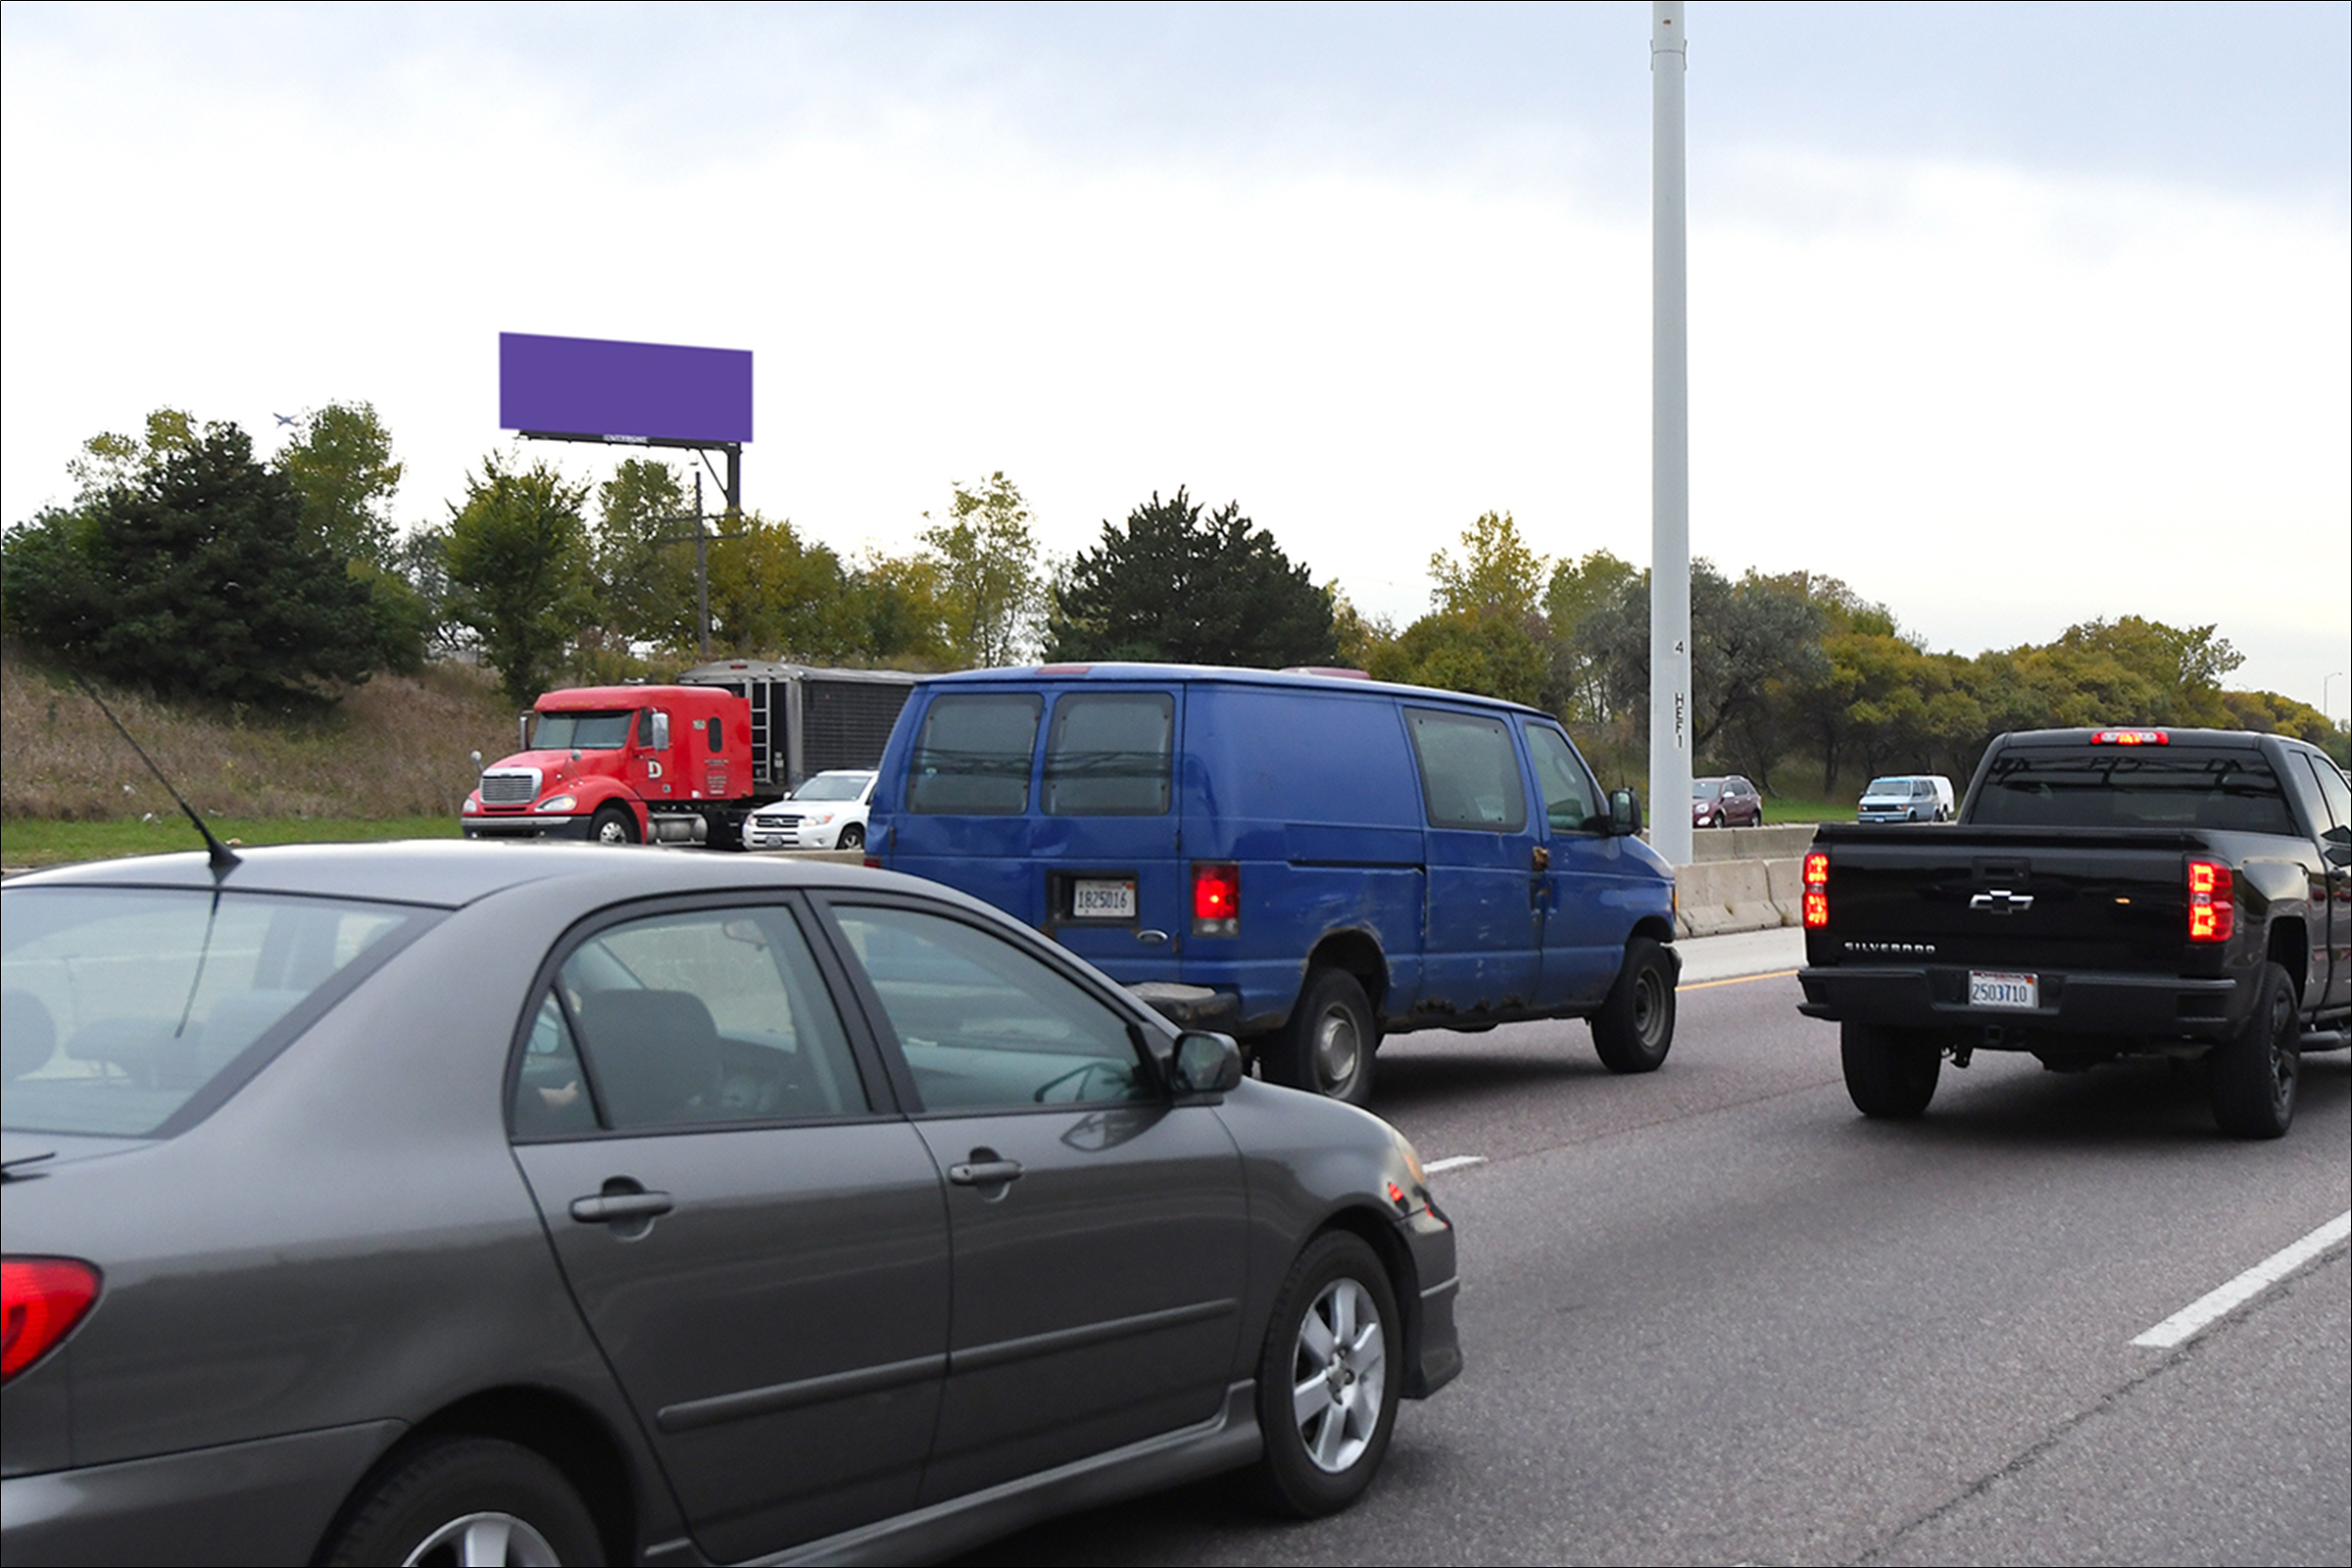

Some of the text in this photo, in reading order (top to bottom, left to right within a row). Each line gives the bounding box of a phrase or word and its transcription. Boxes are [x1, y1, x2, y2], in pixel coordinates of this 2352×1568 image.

[1675, 641, 1684, 654] 4
[1844, 942, 1936, 955] SILVERADO
[1972, 983, 2028, 1003] 2503710
